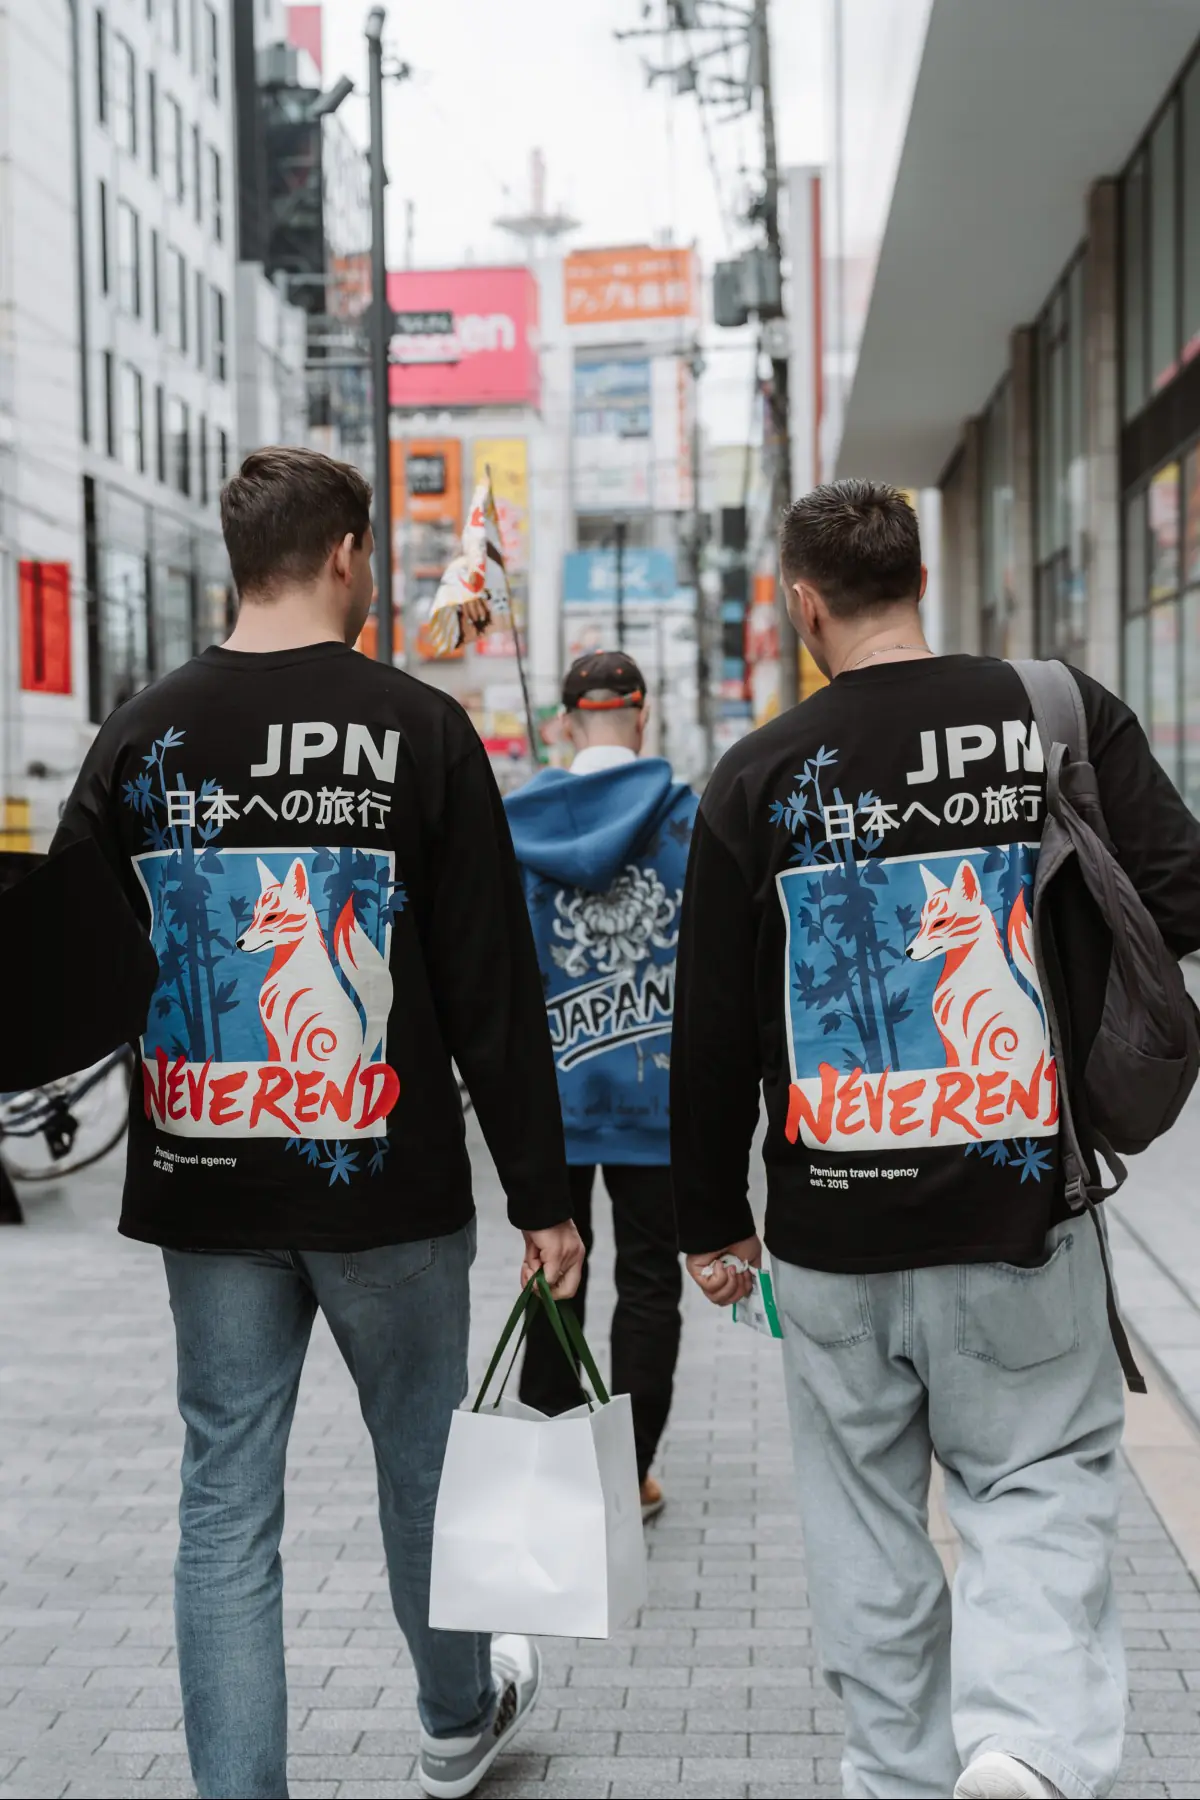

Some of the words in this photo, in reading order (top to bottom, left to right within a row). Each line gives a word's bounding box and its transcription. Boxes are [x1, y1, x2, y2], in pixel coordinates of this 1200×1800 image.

[251, 722, 400, 783] JPN
[906, 719, 1043, 786] JPN
[166, 785, 391, 829] 日本への旅行
[823, 784, 1042, 843] 日本への旅行
[547, 968, 675, 1051] JAPAN
[154, 1145, 175, 1161] Premium
[175, 1153, 199, 1165] travel
[201, 1157, 237, 1168] agency
[162, 1160, 174, 1173] 2015
[810, 1164, 848, 1178] Premium
[849, 1167, 879, 1178] travel
[881, 1168, 919, 1180] agency
[810, 1179, 826, 1188] est.
[827, 1179, 849, 1190] 2015
